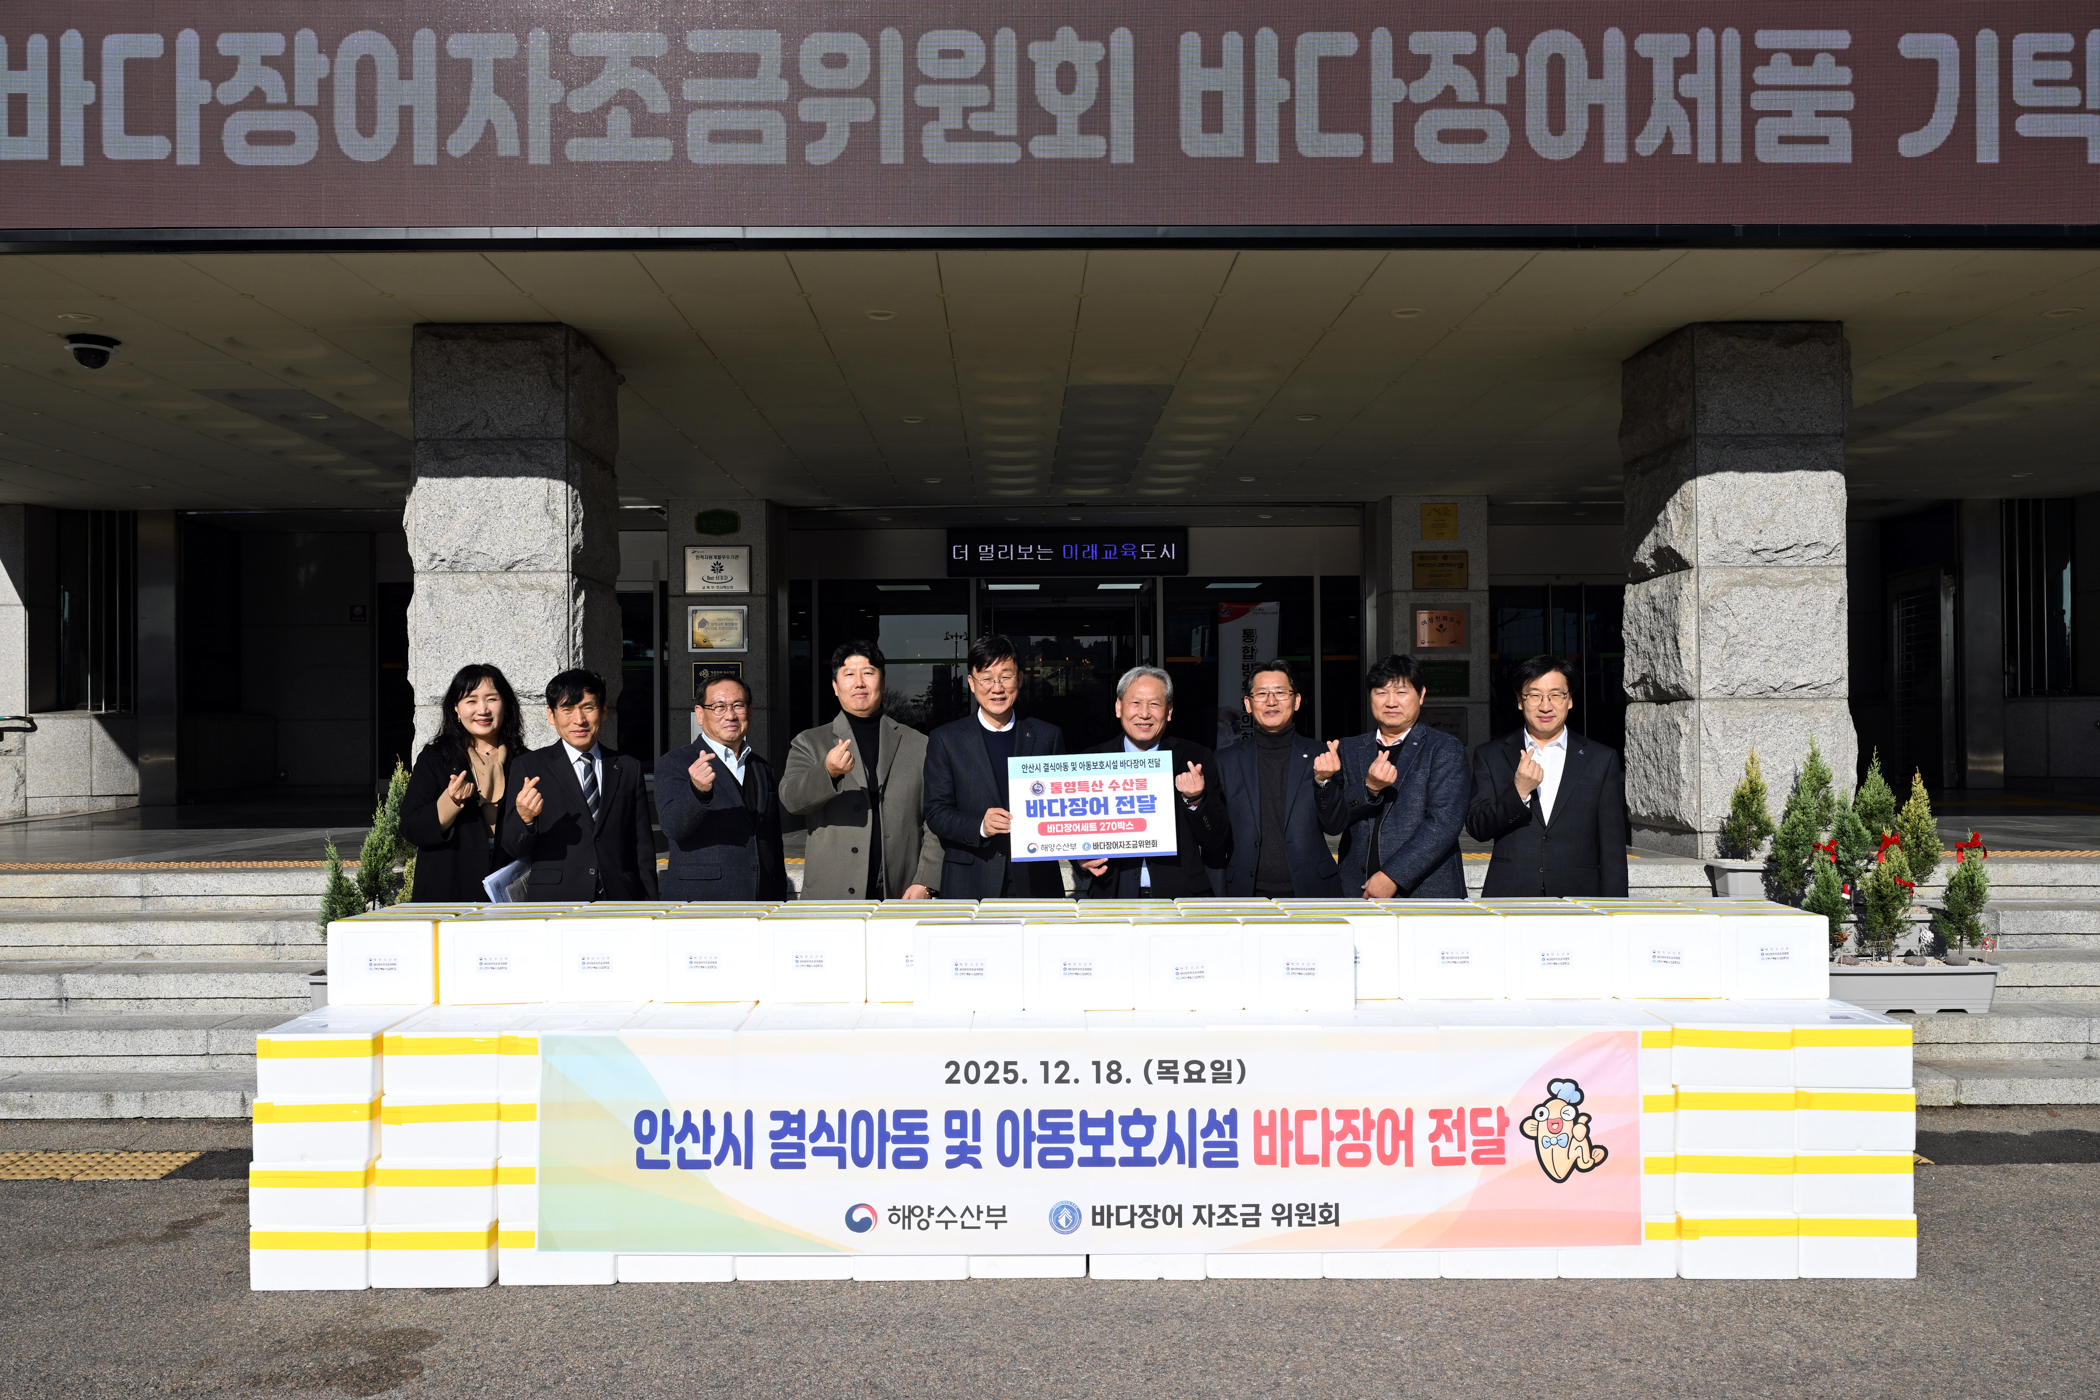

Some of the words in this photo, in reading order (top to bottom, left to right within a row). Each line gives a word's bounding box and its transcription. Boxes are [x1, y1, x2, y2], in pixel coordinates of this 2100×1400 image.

[0, 26, 1134, 167] 바다장어자조금위원회
[1178, 26, 1855, 164] 바다장어제품
[952, 543, 969, 561] 더
[978, 543, 1054, 562] 멀리보는
[1062, 542, 1176, 561] 미래교육도시
[1021, 763, 1041, 773] 안산시
[1042, 761, 1069, 773] 결식아동
[1070, 761, 1078, 772] 및
[1078, 759, 1119, 771] 아동보호시설
[1119, 758, 1147, 770] 바다장어
[1147, 758, 1161, 769] 전달
[1050, 779, 1104, 794] 통영특산
[1108, 778, 1148, 792] 수산물
[1025, 796, 1109, 818] 바다장어
[1115, 794, 1157, 815] 전달
[1046, 822, 1098, 834] 바다장어세트
[1099, 820, 1134, 832] 270박스
[1040, 842, 1077, 852] 해양수산부
[1092, 839, 1158, 851] 바다장어자조금위원회
[944, 1060, 1028, 1085] 2025.
[1039, 1060, 1080, 1085] 12.
[1091, 1060, 1132, 1085] 18.
[1143, 1058, 1246, 1085] (목요일)
[633, 1108, 754, 1170] 안산시
[768, 1109, 930, 1170] 결식아동
[944, 1108, 983, 1169] 및
[996, 1107, 1239, 1169] 아동보호시설
[1253, 1107, 1414, 1168] 바다장어
[1428, 1105, 1511, 1167] 전달
[887, 1204, 1008, 1231] 해양수산부
[1091, 1204, 1183, 1229] 바다장어
[1191, 1203, 1262, 1228] 자조금
[1271, 1202, 1340, 1228] 위원회
